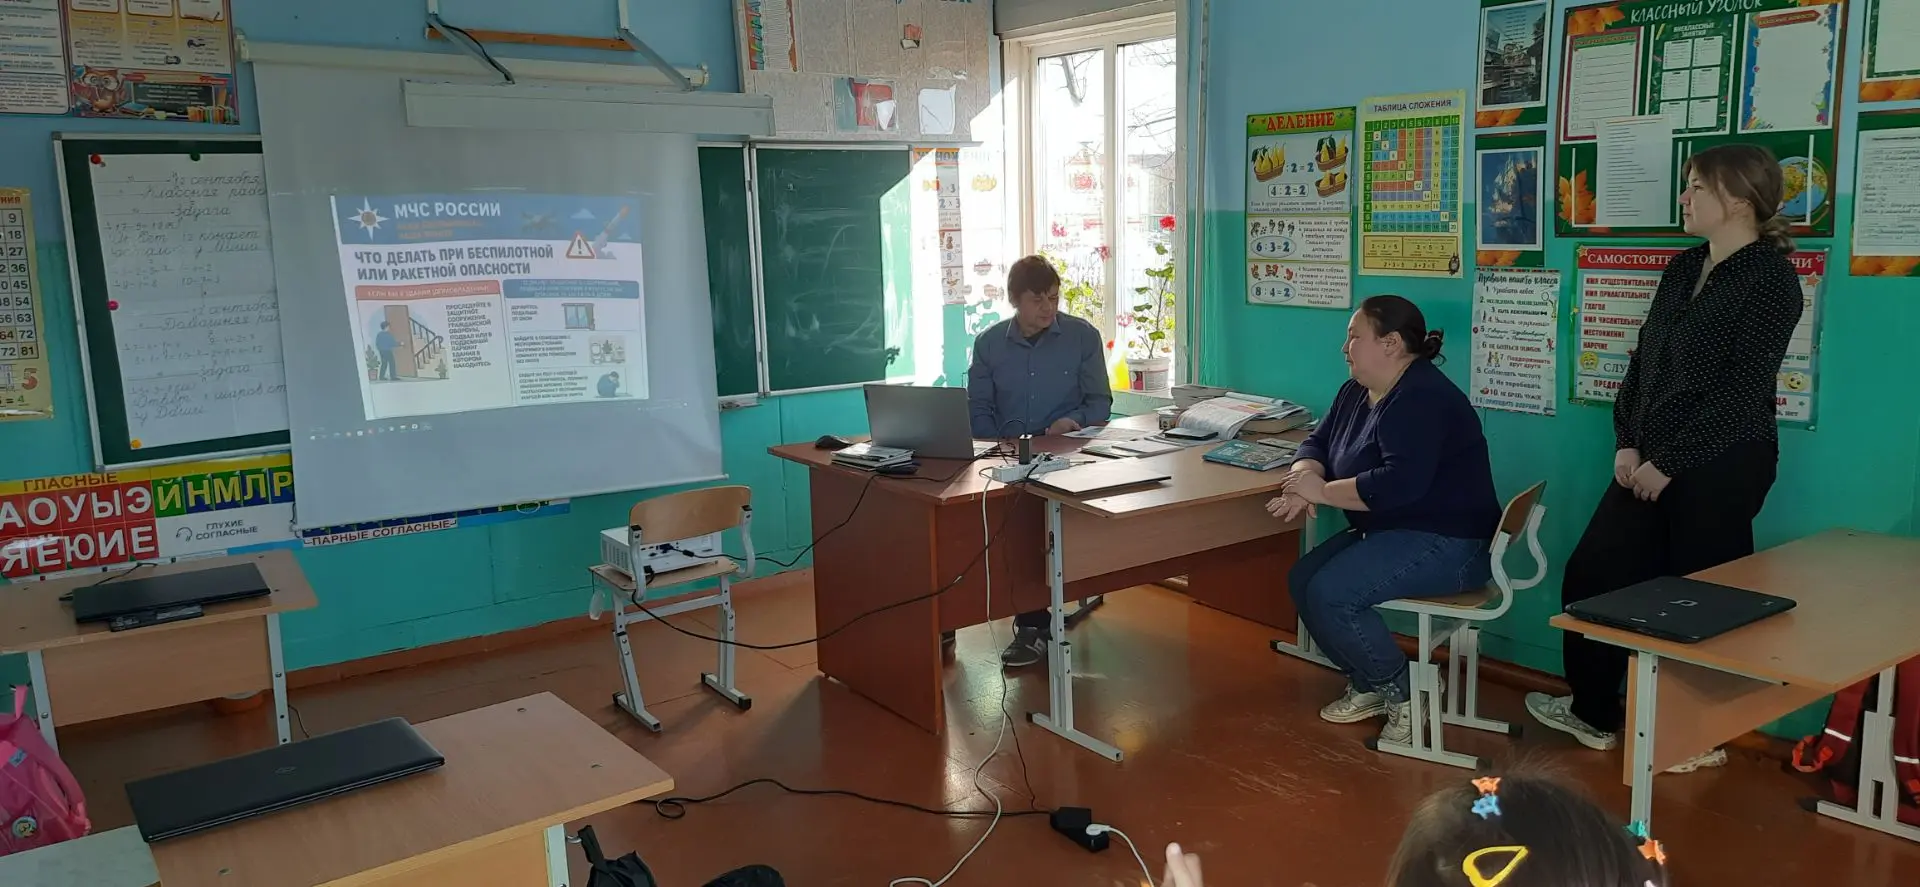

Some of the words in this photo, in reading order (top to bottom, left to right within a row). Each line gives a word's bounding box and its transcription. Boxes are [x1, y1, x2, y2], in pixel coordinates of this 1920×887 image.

[1630, 0, 1702, 23] КЛАССНЫЙ
[1706, 0, 1763, 14] УГОЛОК
[1374, 103, 1407, 113] ТАБЛИЦА
[1408, 100, 1452, 111] СЛОЖЕНИЯ
[1266, 112, 1335, 132] ДЕЛЕНИЕ
[393, 202, 430, 220] МЧС
[434, 200, 502, 218] РОССИИ
[9, 213, 16, 224] 9
[8, 230, 21, 240] 18
[9, 247, 24, 257] 27
[354, 250, 384, 264] ЧТО
[386, 249, 436, 266] ДЕЛАТЬ
[439, 248, 464, 261] ПРИ
[467, 244, 554, 260] БЕСПИЛОТНОЙ
[1587, 253, 1672, 266] САМОСТОЯТЕ
[11, 263, 26, 273] 36
[357, 268, 388, 281] ИЛИ
[391, 262, 457, 281] РАКЕТНОЙ
[459, 262, 531, 277] ОПАСНОСТИ
[13, 280, 28, 290] 45
[1586, 277, 1599, 285] ИМЯ
[1600, 278, 1658, 287] СУЩЕСТВИТЕЛЬНОЕ
[1600, 290, 1651, 299] ПРИЛАГАТЕЛЬНОЕ
[15, 297, 29, 307] 54
[1584, 303, 1606, 311] ГЛАГОЛ
[17, 313, 32, 323] 63
[1600, 317, 1643, 326] ЧИСЛИТЕЛЬНОЕ
[0, 332, 13, 342] 64
[19, 329, 33, 339] 72
[1583, 329, 1625, 338] МЕСТОИМЕНИЕ
[2, 347, 16, 357] 72
[21, 346, 35, 356] 81
[1603, 362, 1627, 374] СЛУ
[1593, 380, 1624, 389] ПРЕДЛО
[23, 472, 119, 492] ГЛАСНЫЕ
[206, 520, 245, 531] ГЛУХИЕ
[195, 525, 259, 541] СОГЛАСНЫЕ
[312, 530, 370, 547] ПАРНЫЕ
[372, 518, 451, 539] СОГЛАСНЫЕ
